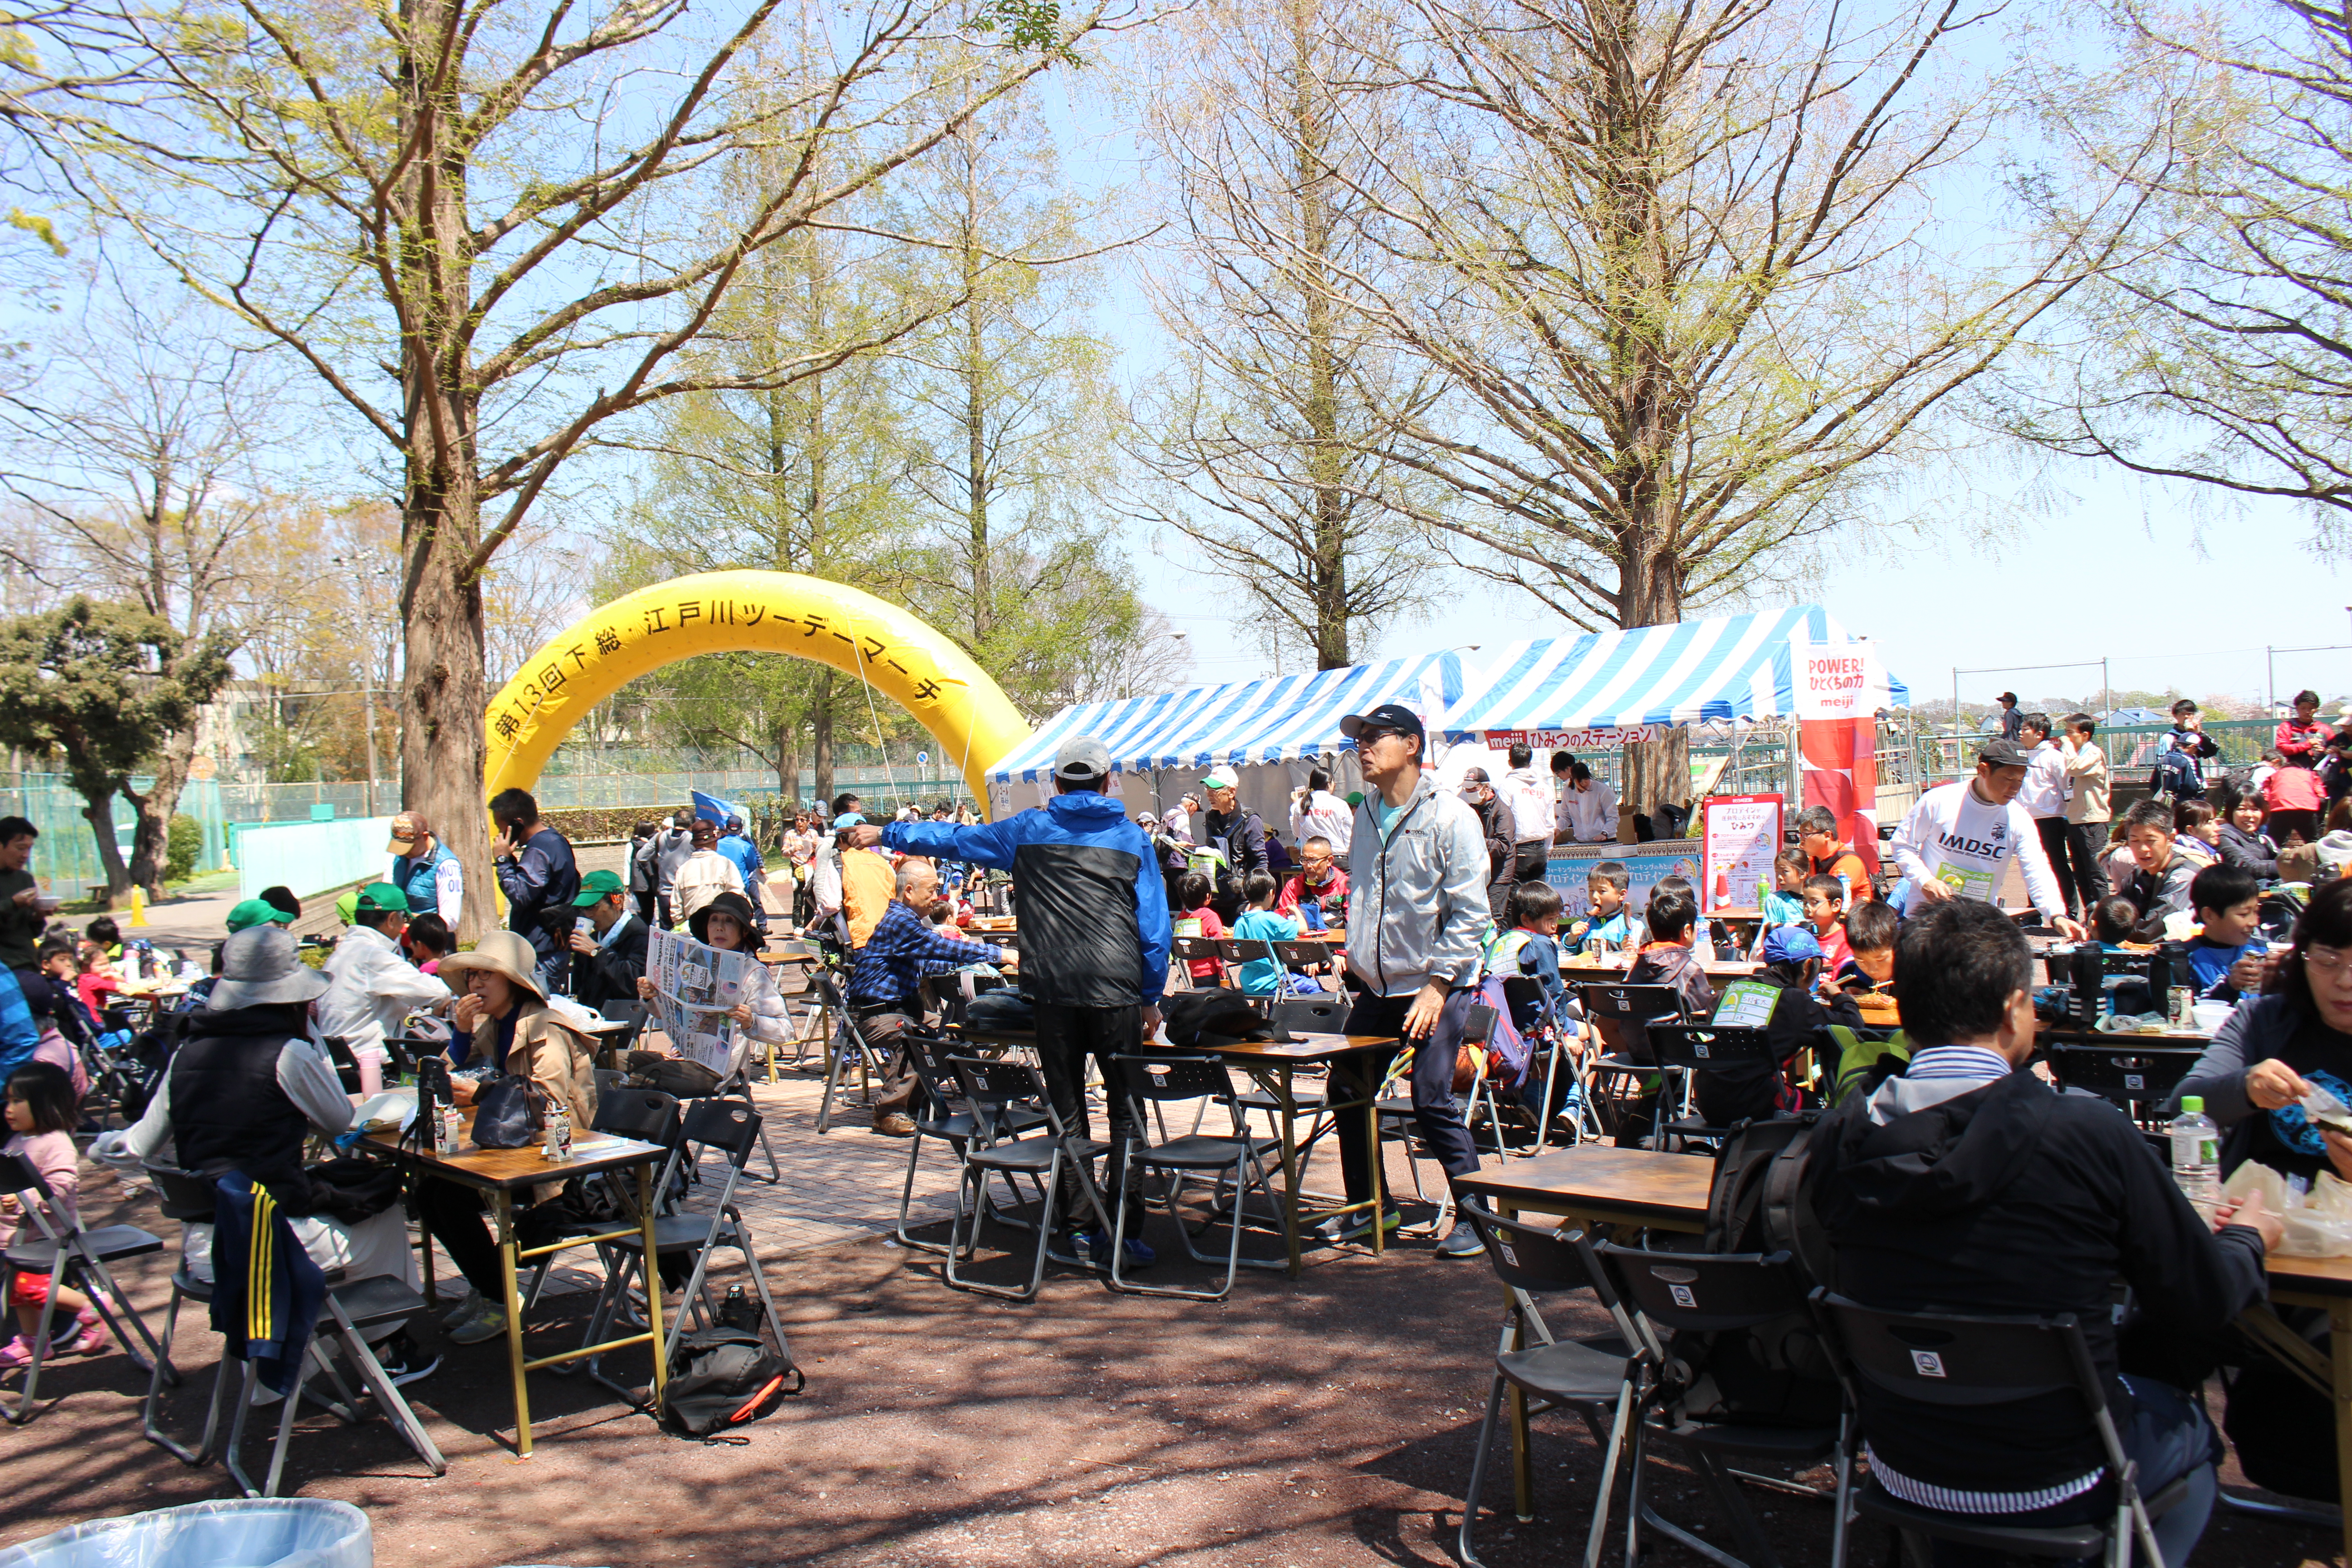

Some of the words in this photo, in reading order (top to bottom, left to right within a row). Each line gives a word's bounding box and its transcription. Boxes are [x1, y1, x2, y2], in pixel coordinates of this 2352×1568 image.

[1808, 657, 1864, 674] POWER!
[1809, 674, 1864, 691] ひとくちの力
[1821, 695, 1853, 709] meiji
[1490, 732, 1523, 748] meiji
[1530, 727, 1651, 748] ひみつのステーション
[1522, 787, 1545, 799] meiji
[1938, 832, 2006, 859] IMDSC
